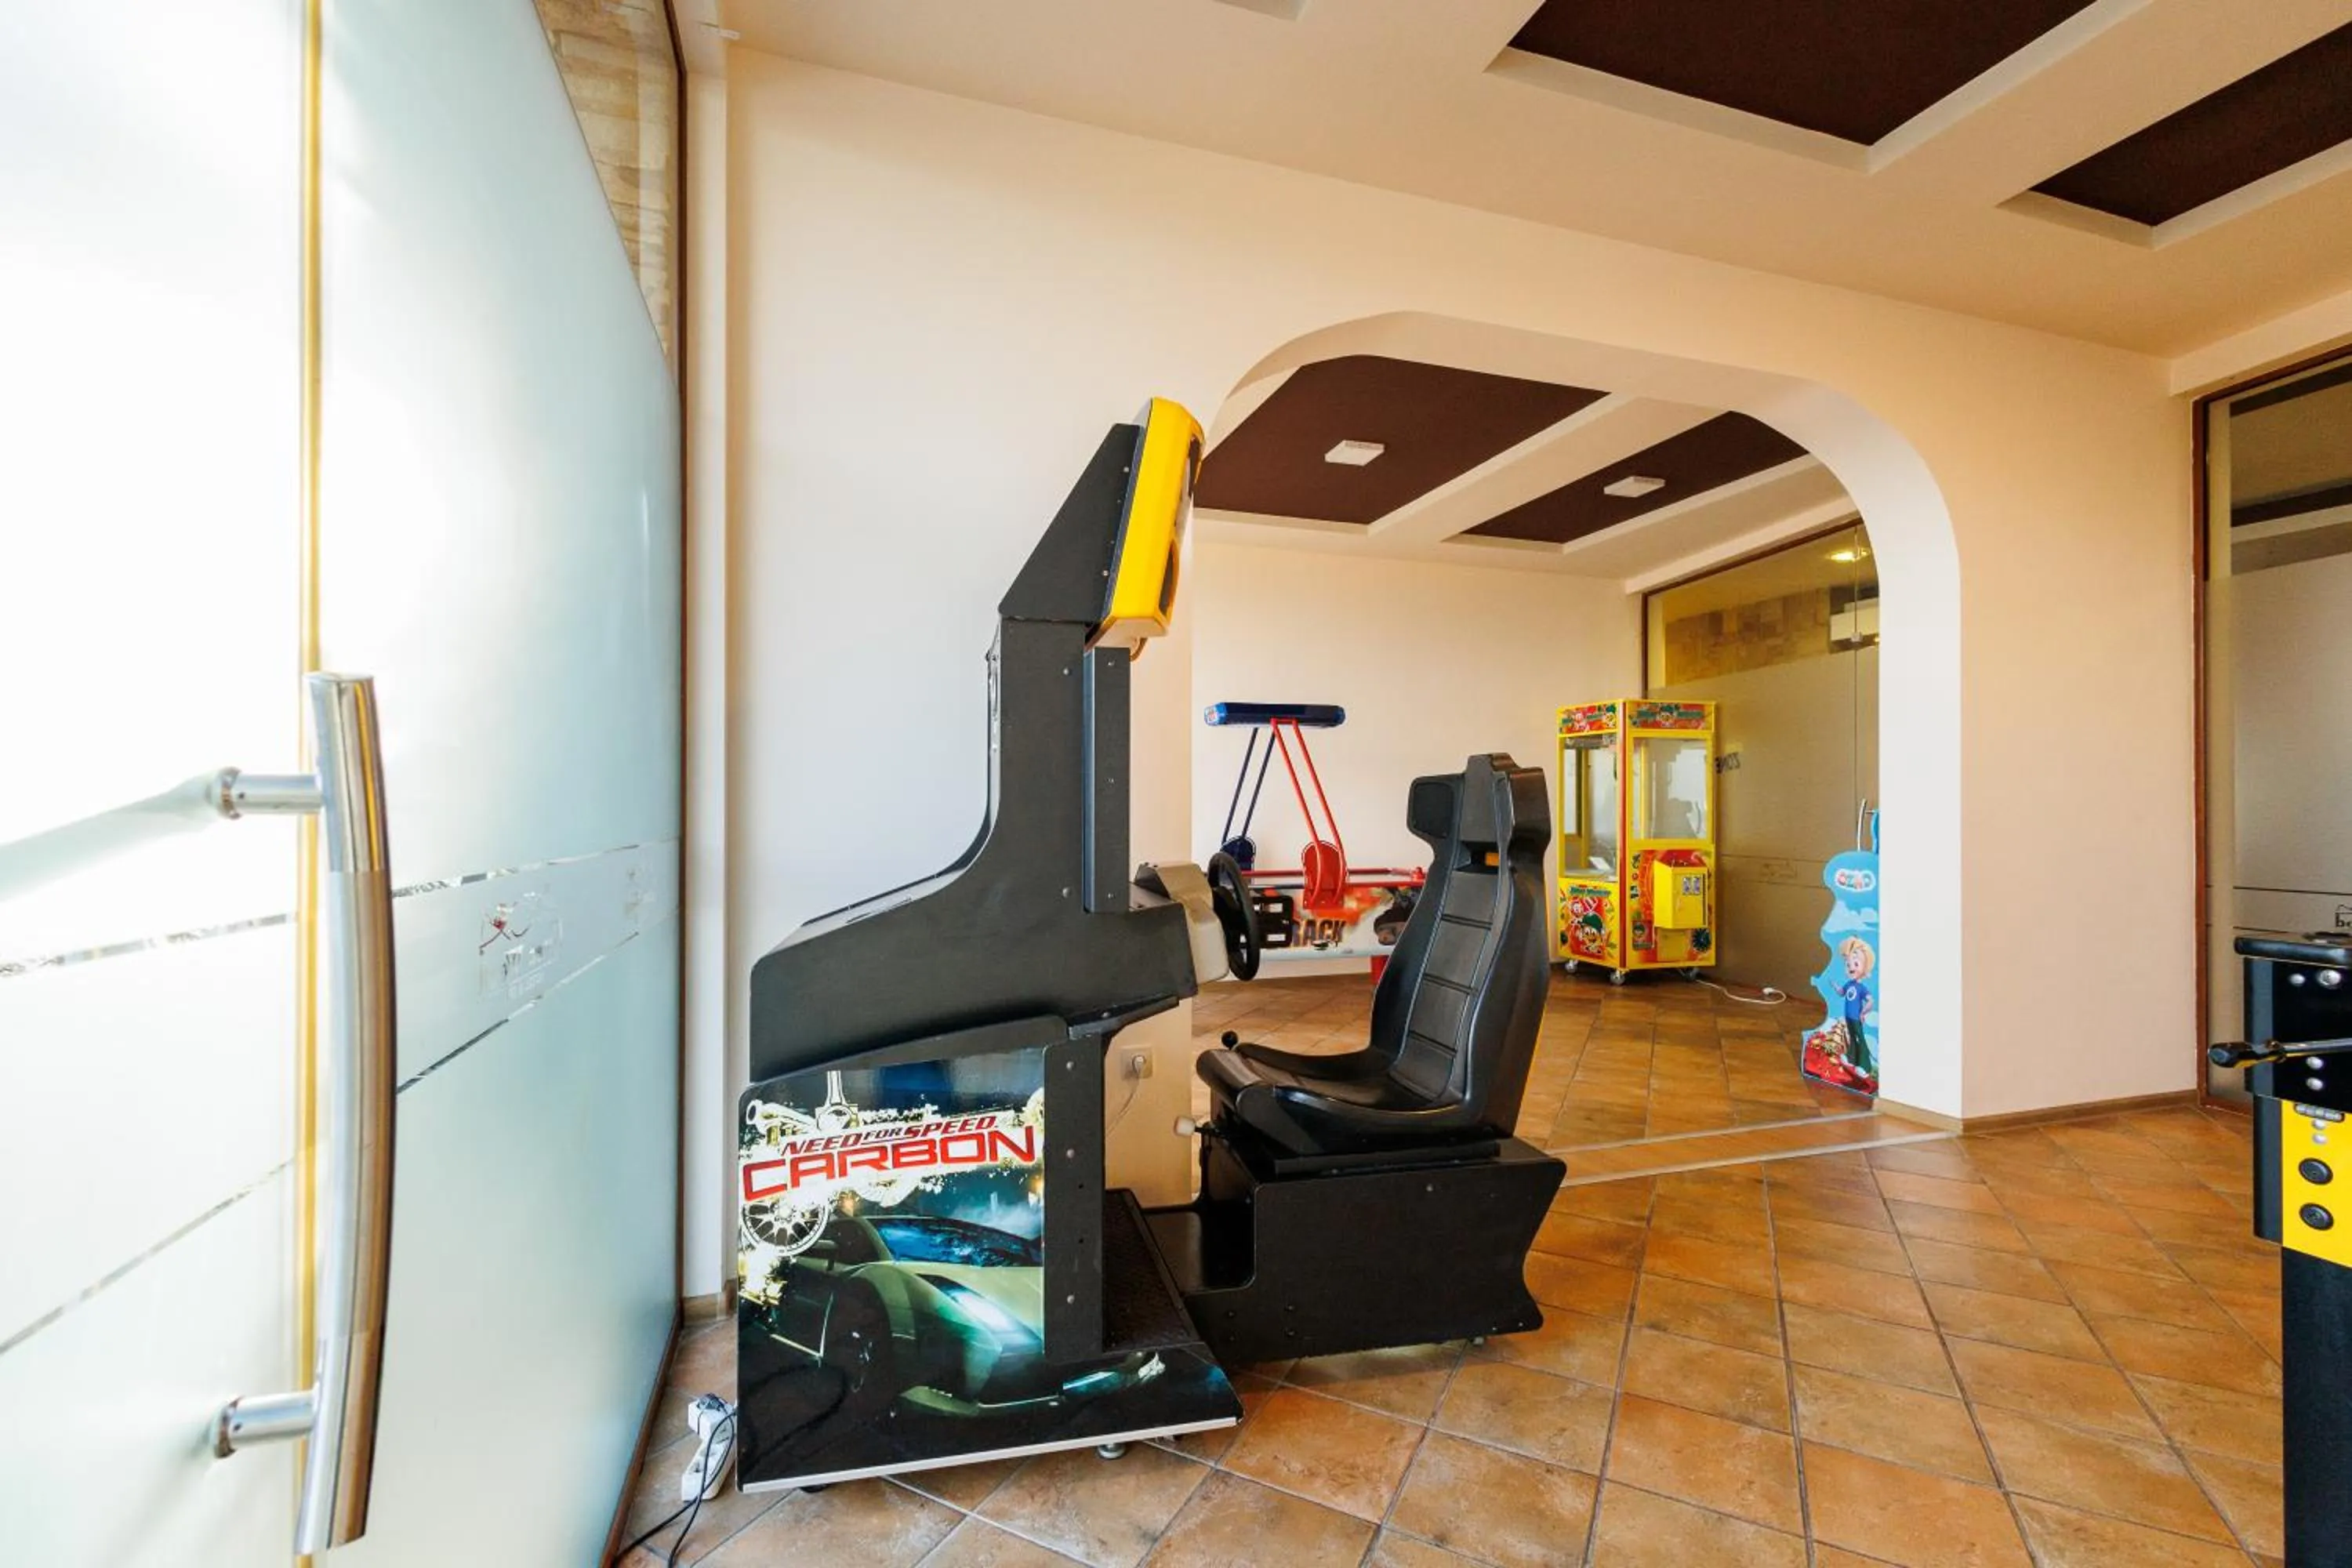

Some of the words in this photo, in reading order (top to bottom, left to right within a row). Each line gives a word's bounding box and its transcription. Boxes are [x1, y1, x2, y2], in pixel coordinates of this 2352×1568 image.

[742, 1124, 1036, 1202] CARBON
[780, 1132, 863, 1156] NEED
[863, 1127, 902, 1142] FOR
[903, 1115, 998, 1139] SPEED
